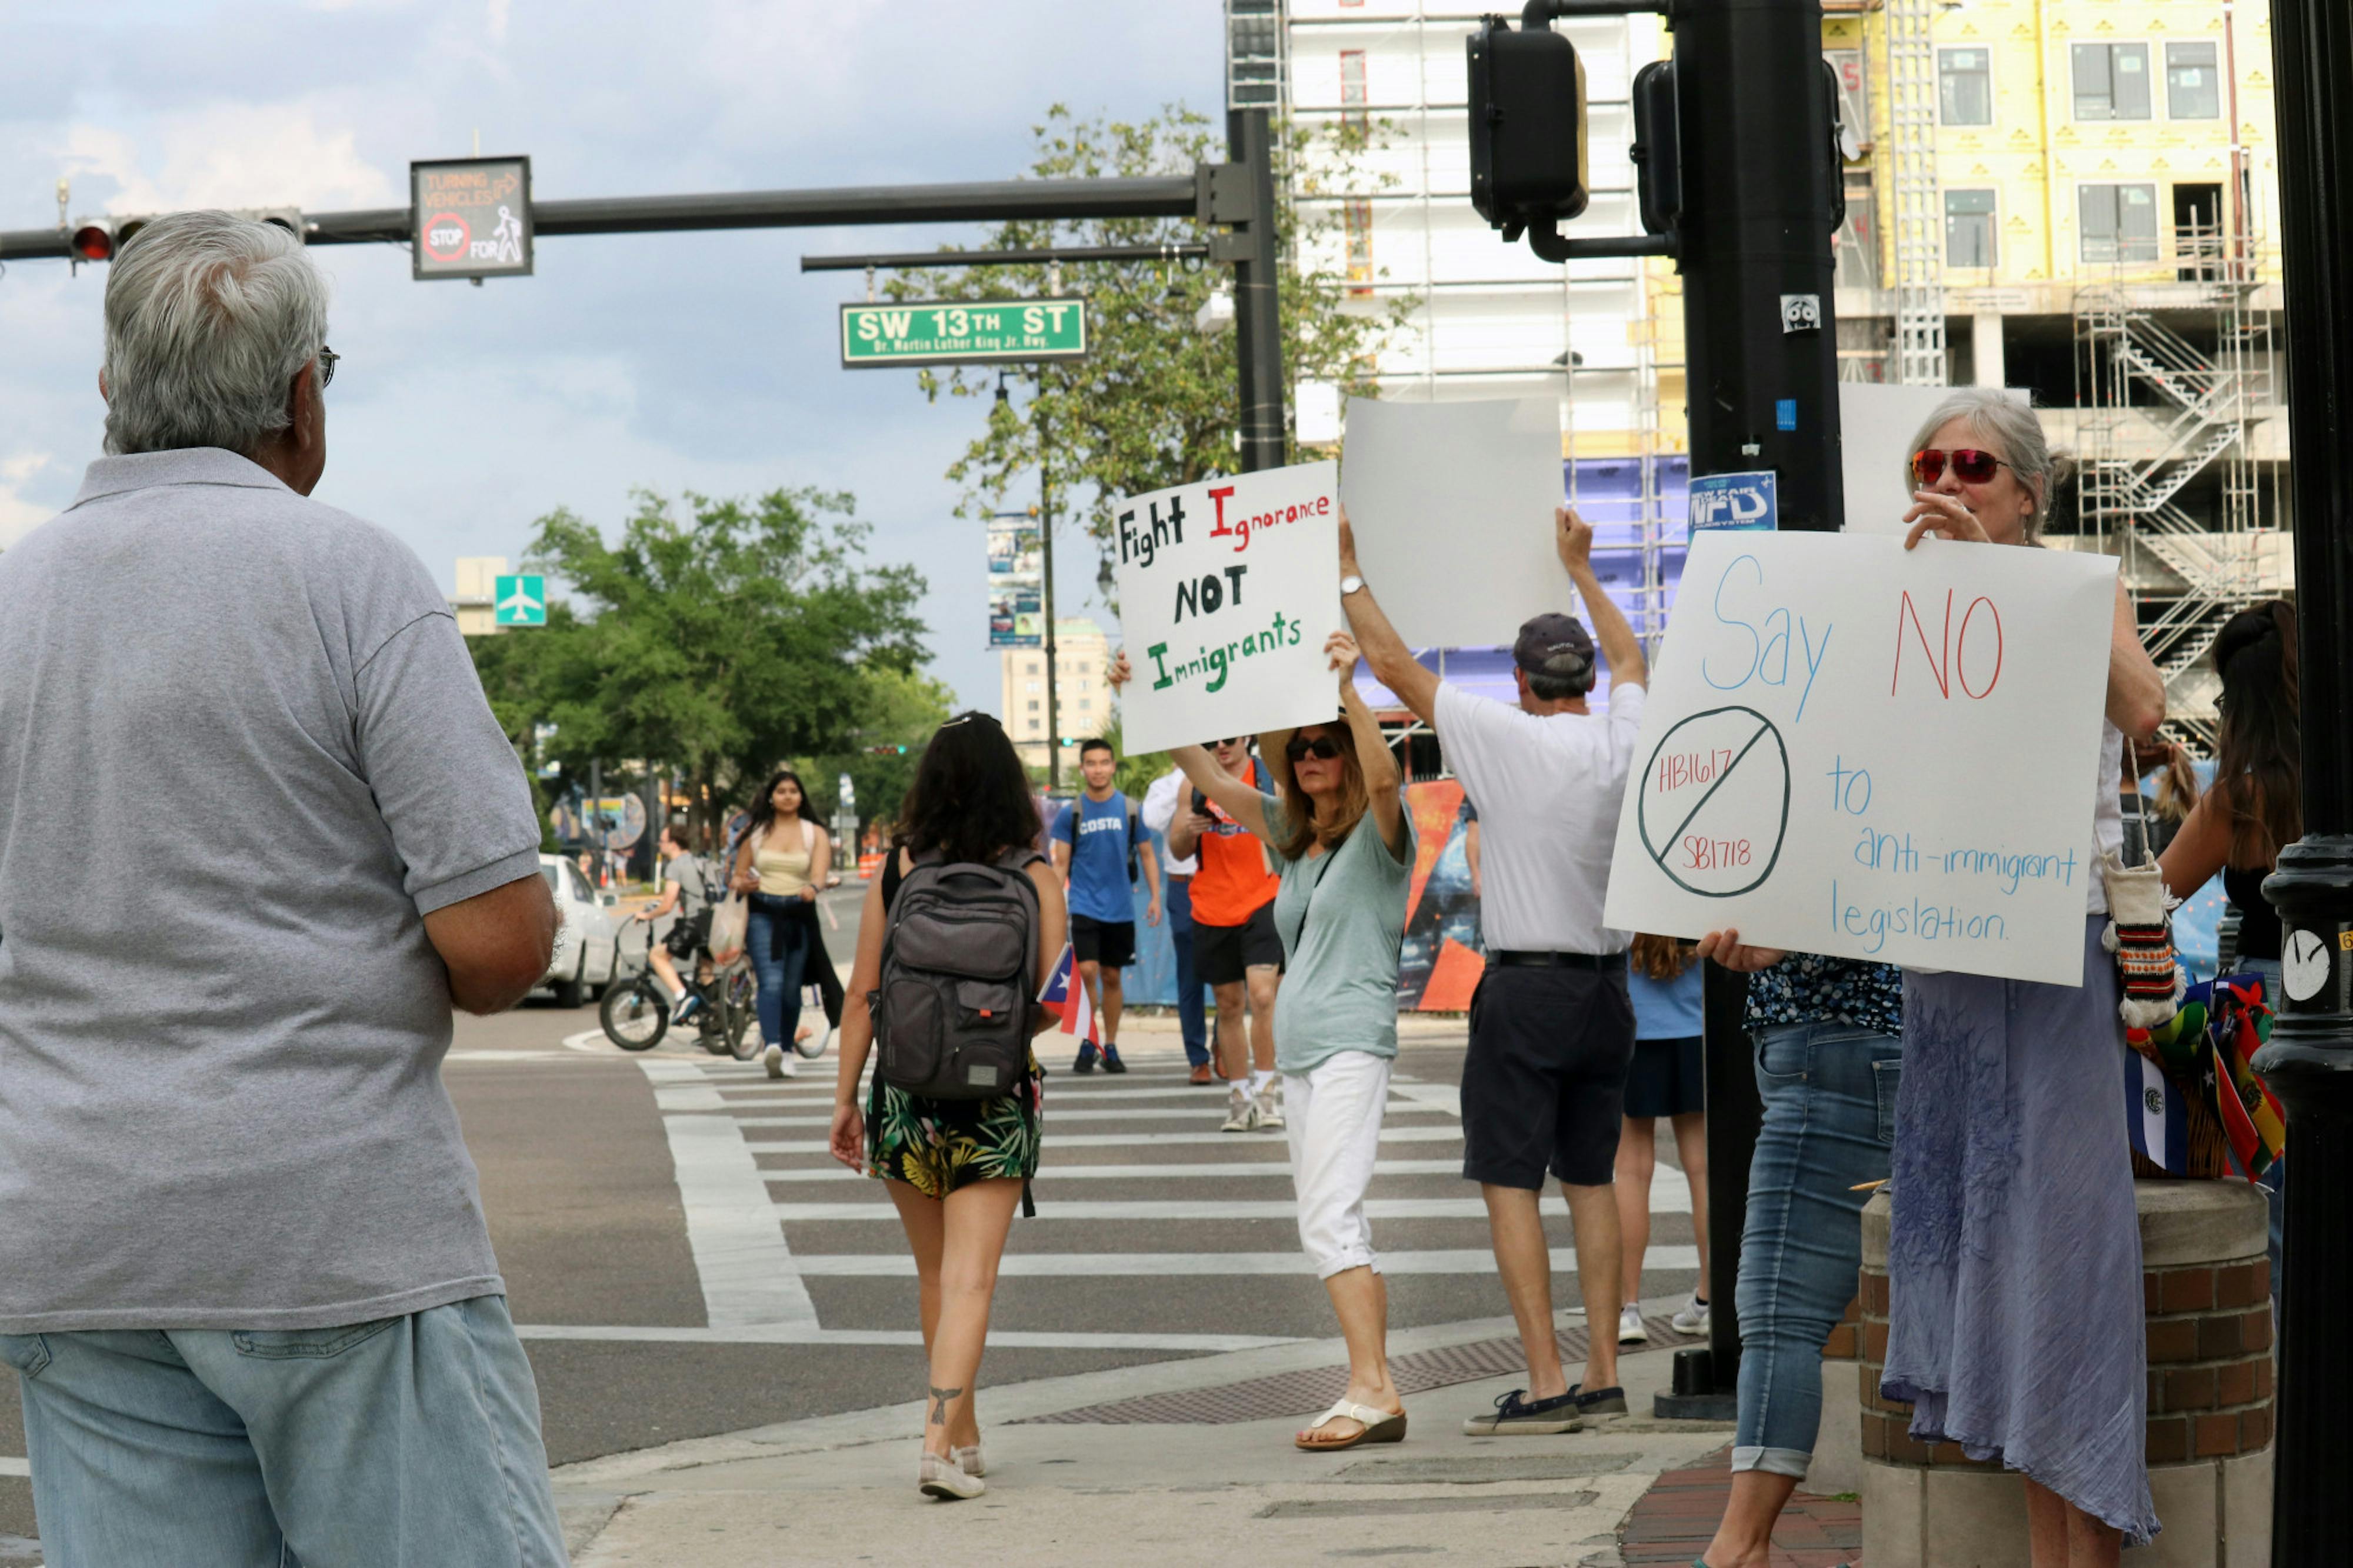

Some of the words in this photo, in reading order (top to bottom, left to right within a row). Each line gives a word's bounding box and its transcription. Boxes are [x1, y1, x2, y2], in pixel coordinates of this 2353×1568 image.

[426, 172, 488, 189] TURNING
[424, 189, 494, 208] VEHICLES
[429, 228, 463, 246] STOP
[471, 240, 498, 258] FOR
[857, 312, 912, 341] SW
[932, 309, 1000, 337] 13TH
[1023, 306, 1068, 334] ST
[894, 338, 932, 352] Martin
[934, 337, 971, 351] Luther
[975, 336, 1001, 351] King
[1004, 335, 1021, 348] Jr.
[1717, 487, 1756, 496] FAIR
[1118, 495, 1186, 568] Fight
[1208, 485, 1330, 553] Ignorance
[1689, 493, 1768, 526] NFD
[1174, 565, 1247, 625] NOT
[1147, 611, 1301, 693] Immigrants
[1702, 555, 1832, 723] Say
[1892, 588, 2003, 700] NO
[1659, 749, 1732, 793] HB1617
[1827, 755, 1872, 816] to
[1079, 817, 1123, 835] COSTA
[1682, 835, 1752, 870] SB1718
[1854, 827, 2078, 895] anti-immigrant
